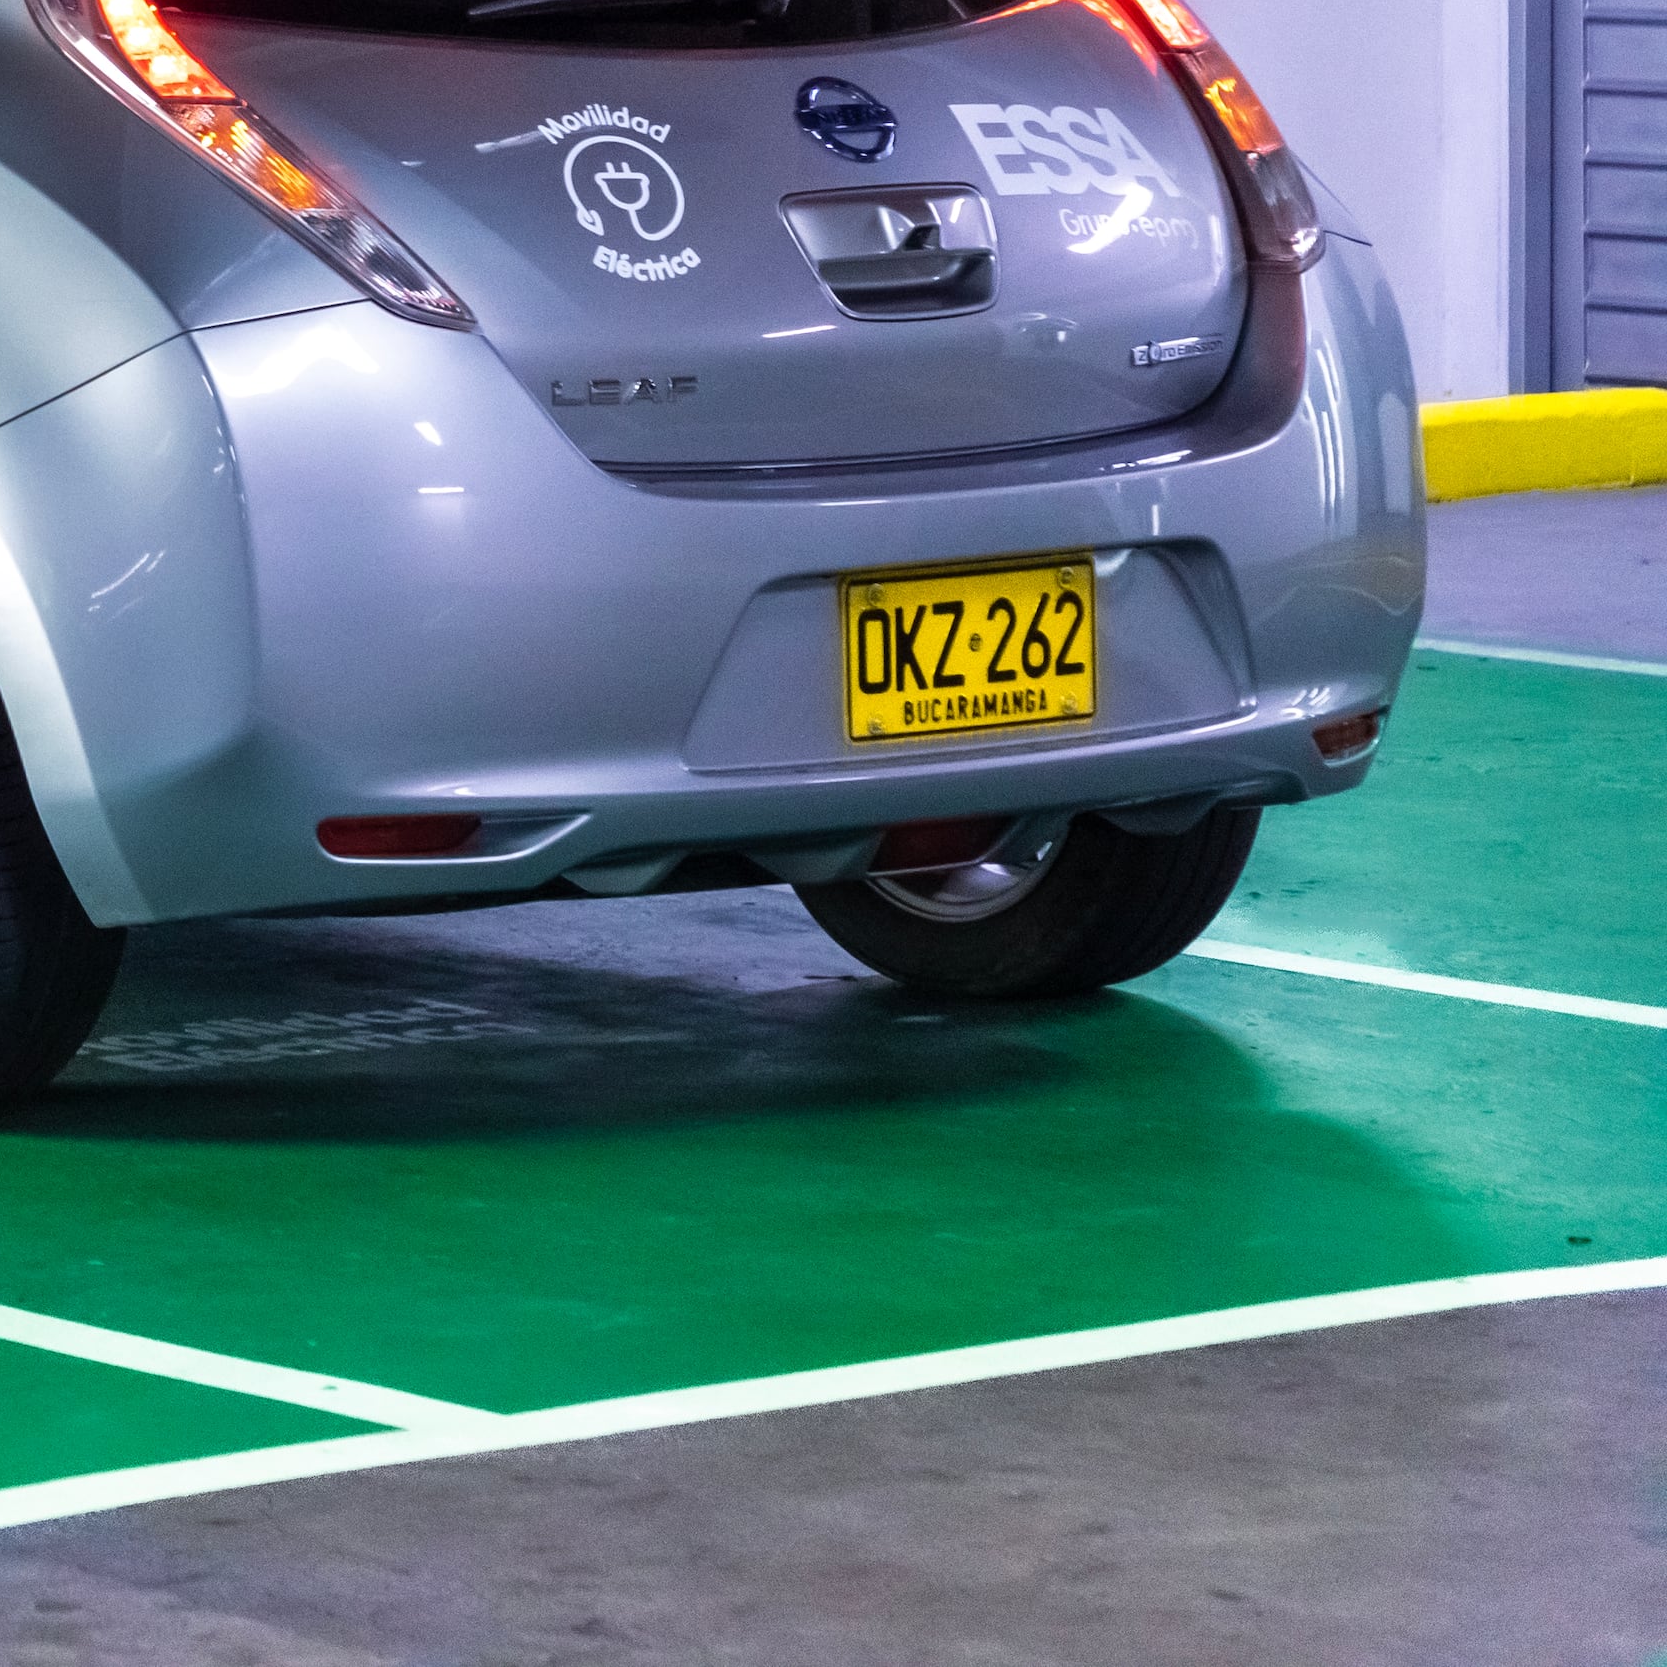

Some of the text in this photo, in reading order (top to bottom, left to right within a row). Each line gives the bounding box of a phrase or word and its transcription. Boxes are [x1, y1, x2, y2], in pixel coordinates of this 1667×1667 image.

[537, 103, 671, 145] Movilidad
[947, 103, 1181, 198] ESSA
[593, 245, 701, 282] Eléctrica
[552, 376, 698, 406] LEAF
[903, 688, 1048, 726] BUCARAMANGA
